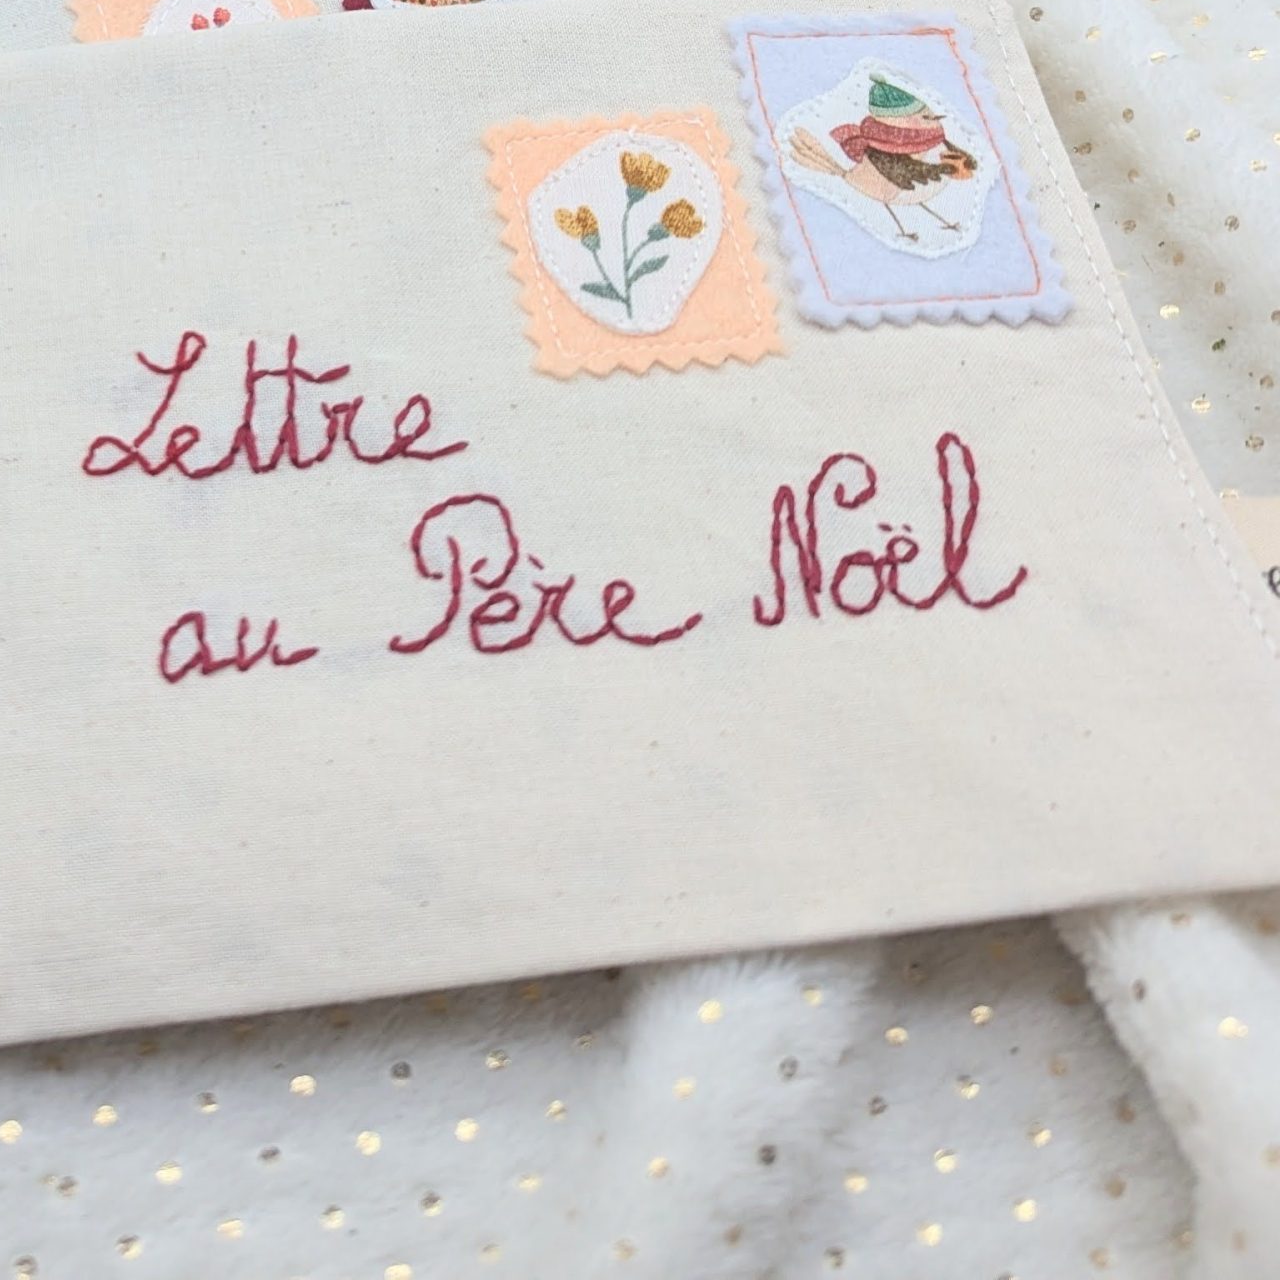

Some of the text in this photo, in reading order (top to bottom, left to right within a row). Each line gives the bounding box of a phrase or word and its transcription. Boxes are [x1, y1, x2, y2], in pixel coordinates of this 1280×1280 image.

[82, 331, 468, 481] Lettre
[158, 431, 1029, 684] au Père Noël
